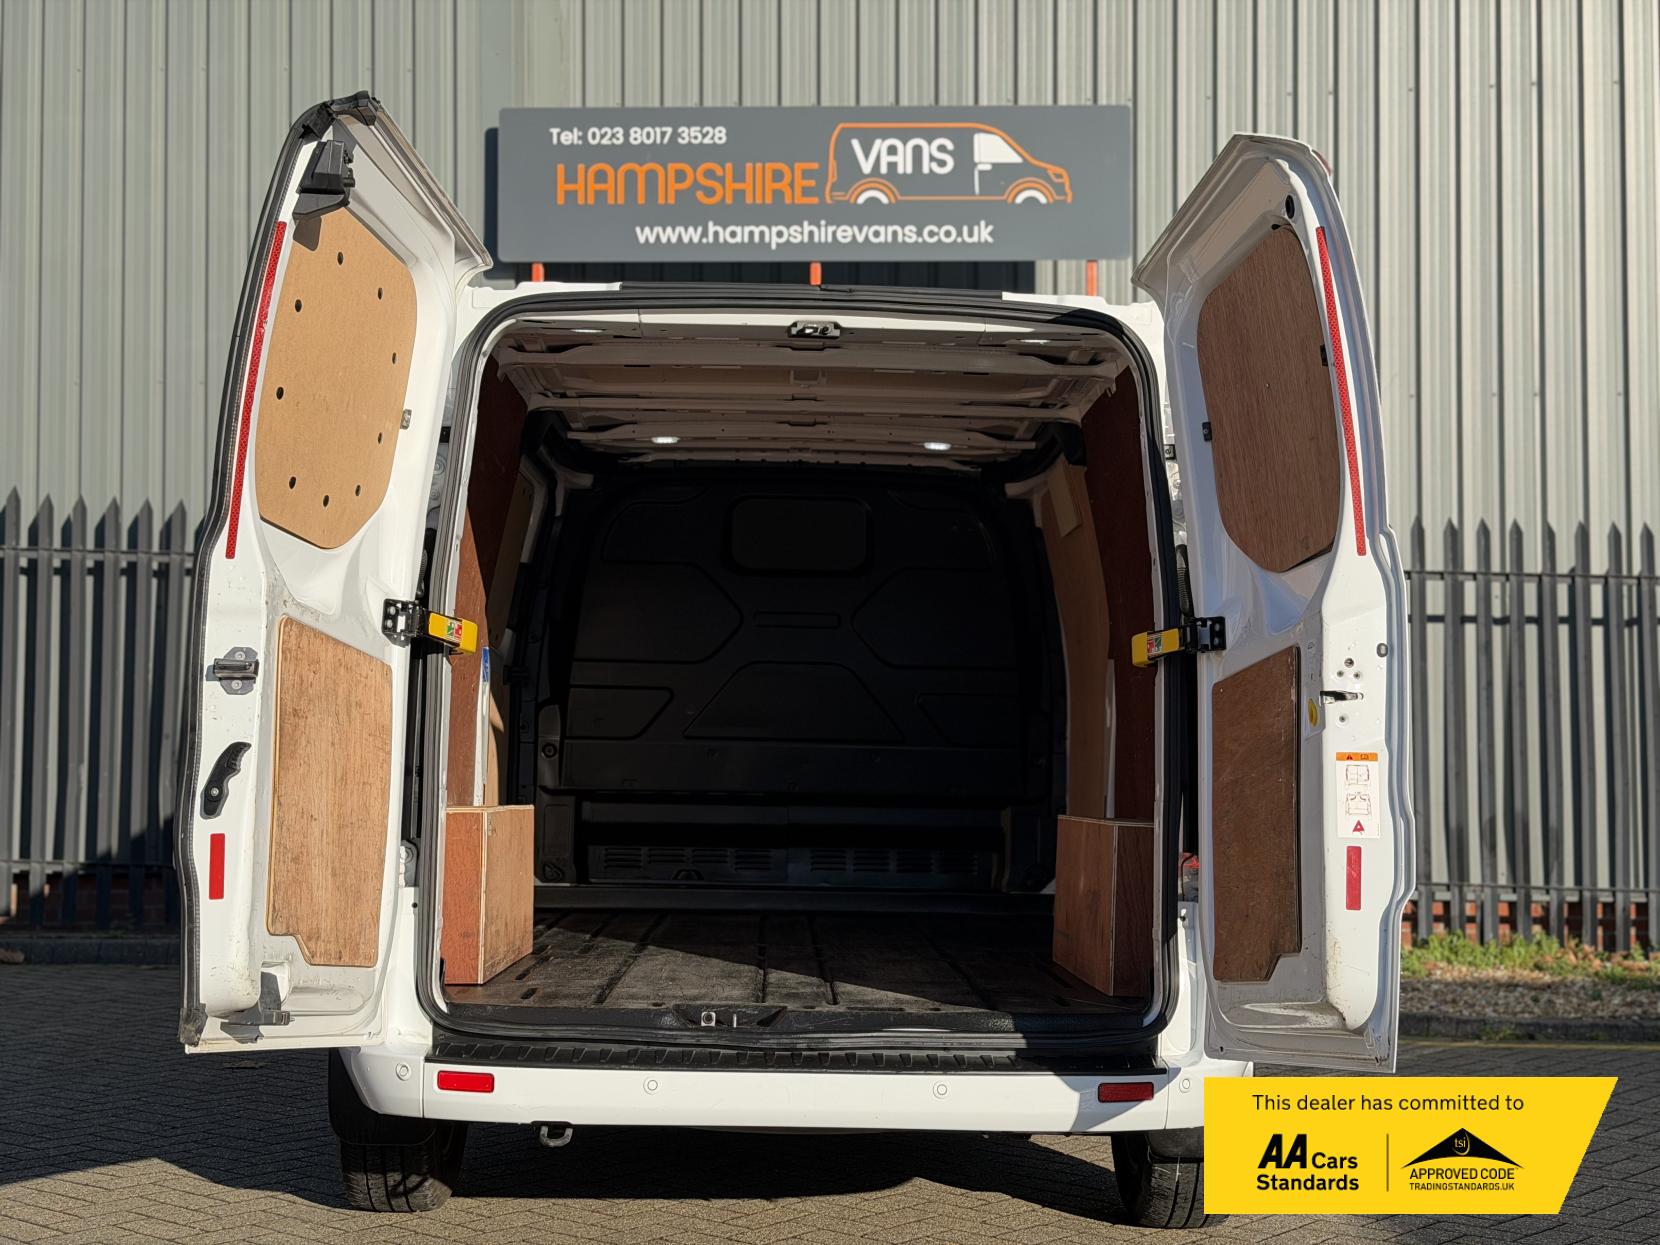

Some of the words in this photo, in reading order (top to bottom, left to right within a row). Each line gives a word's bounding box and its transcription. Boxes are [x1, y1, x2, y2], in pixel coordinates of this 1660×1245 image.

[549, 127, 583, 146] Tel:
[587, 126, 625, 145] 023
[628, 126, 673, 146] 8017
[677, 125, 727, 145] 3528
[556, 162, 820, 206] HAMPSHIRE
[850, 137, 955, 175] VANS
[635, 219, 995, 251] www.hampshirevans.co.uk
